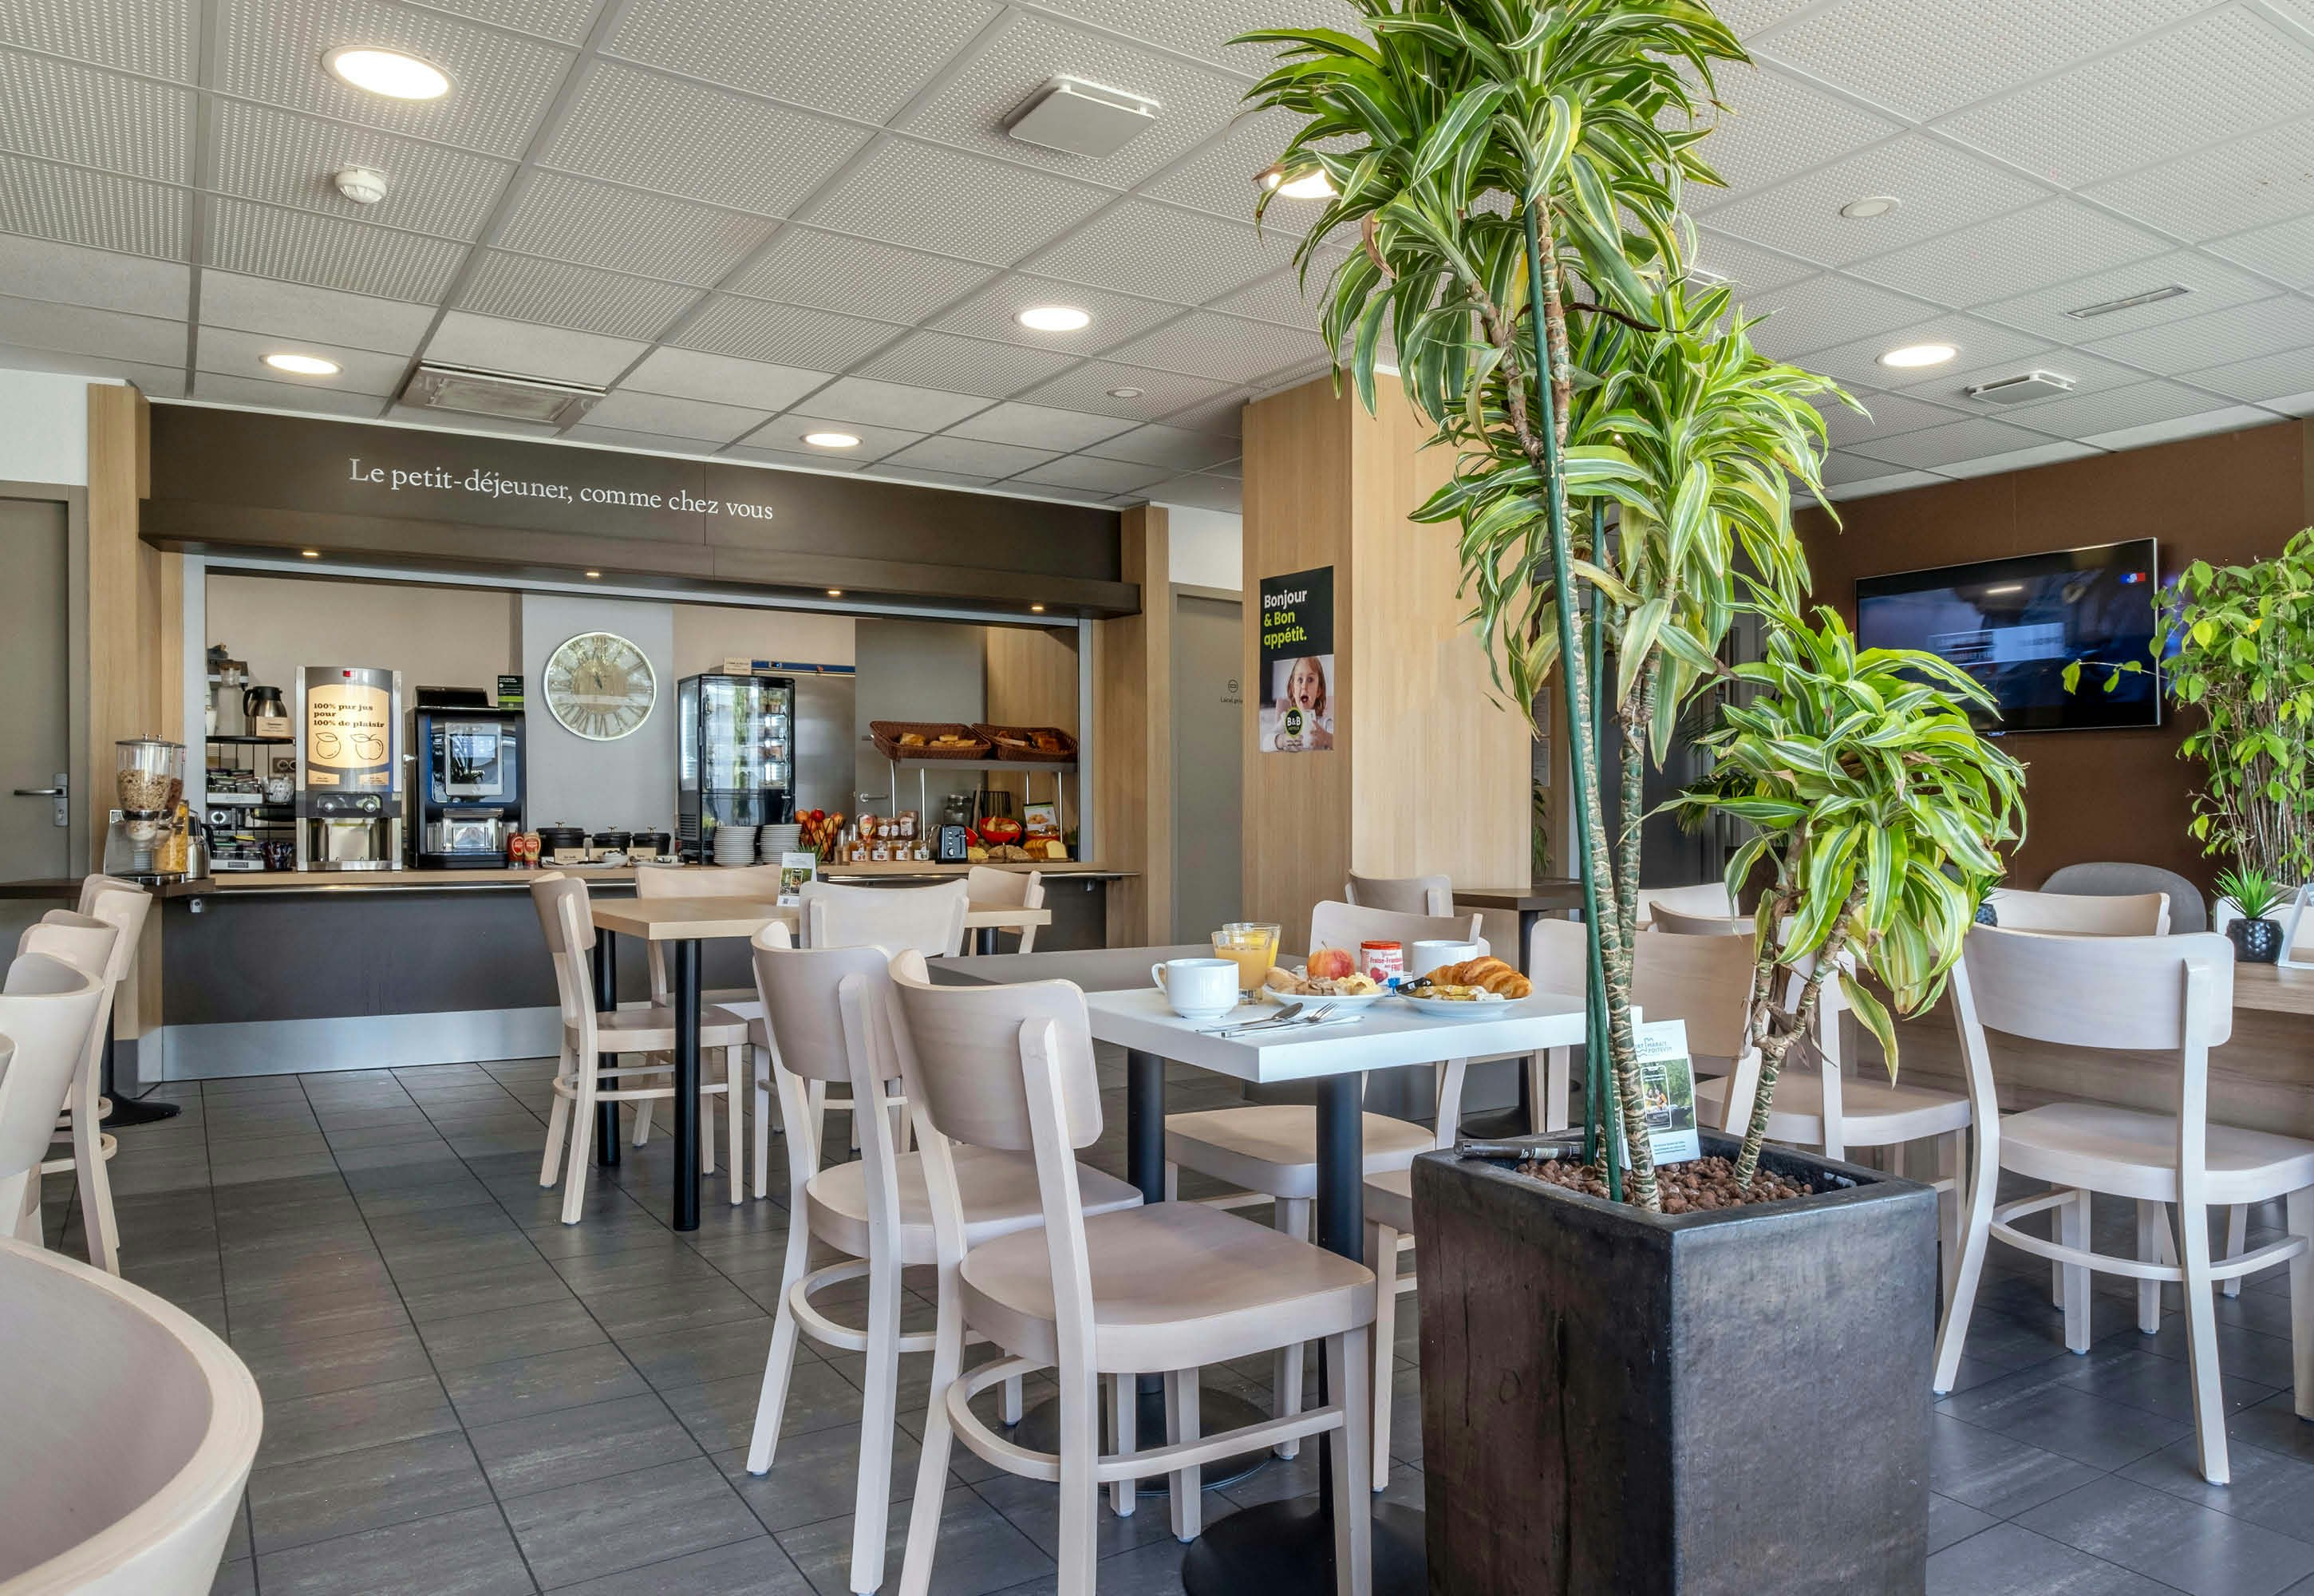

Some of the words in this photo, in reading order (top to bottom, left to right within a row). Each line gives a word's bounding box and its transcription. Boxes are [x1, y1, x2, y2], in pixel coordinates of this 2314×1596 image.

[349, 458, 385, 483] Le
[391, 467, 573, 503] petit-déjeuner,
[580, 487, 661, 508] comme
[669, 490, 719, 514] chez
[726, 502, 773, 519] vous
[1264, 590, 1308, 610] Bonjour
[1264, 613, 1272, 627] &
[1274, 611, 1295, 626] Bon
[1264, 626, 1307, 650] appétit.
[1287, 717, 1301, 726] B&B
